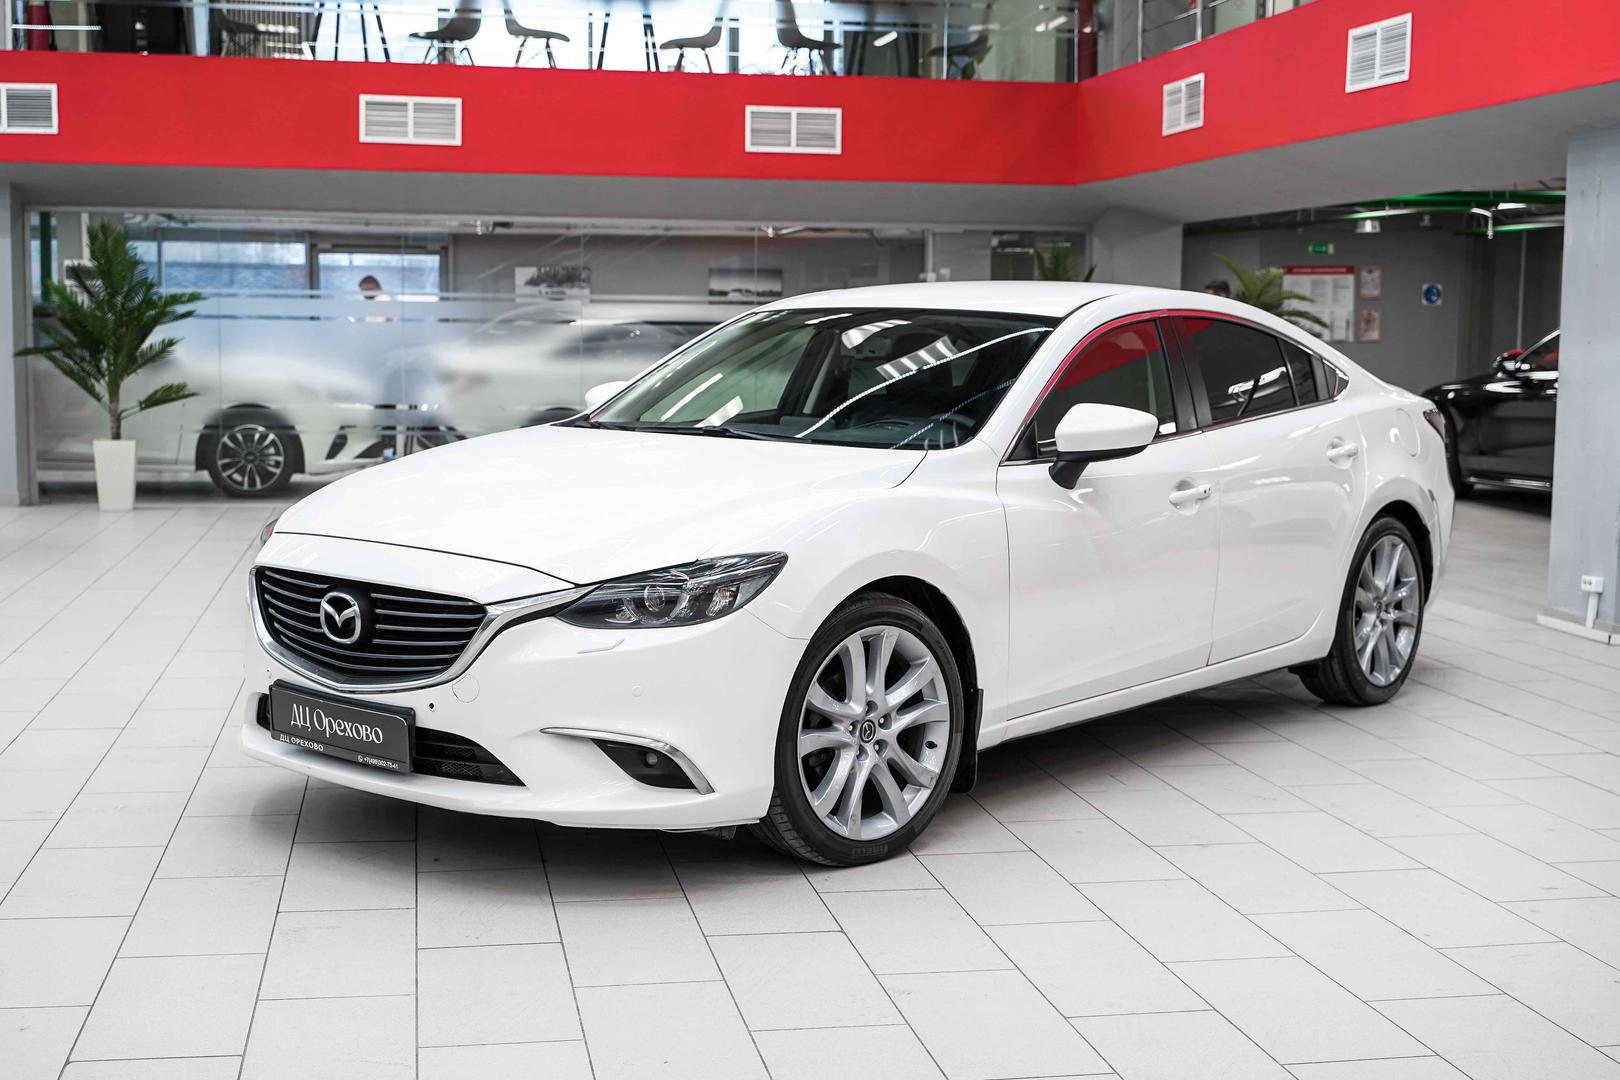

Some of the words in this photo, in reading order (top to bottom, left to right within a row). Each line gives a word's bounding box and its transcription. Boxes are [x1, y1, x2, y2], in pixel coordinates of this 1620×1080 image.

[291, 704, 311, 731] ДЦ
[313, 709, 383, 743] Орехово
[279, 734, 290, 743] ДЦ
[291, 737, 324, 752] ОРЕХОВО
